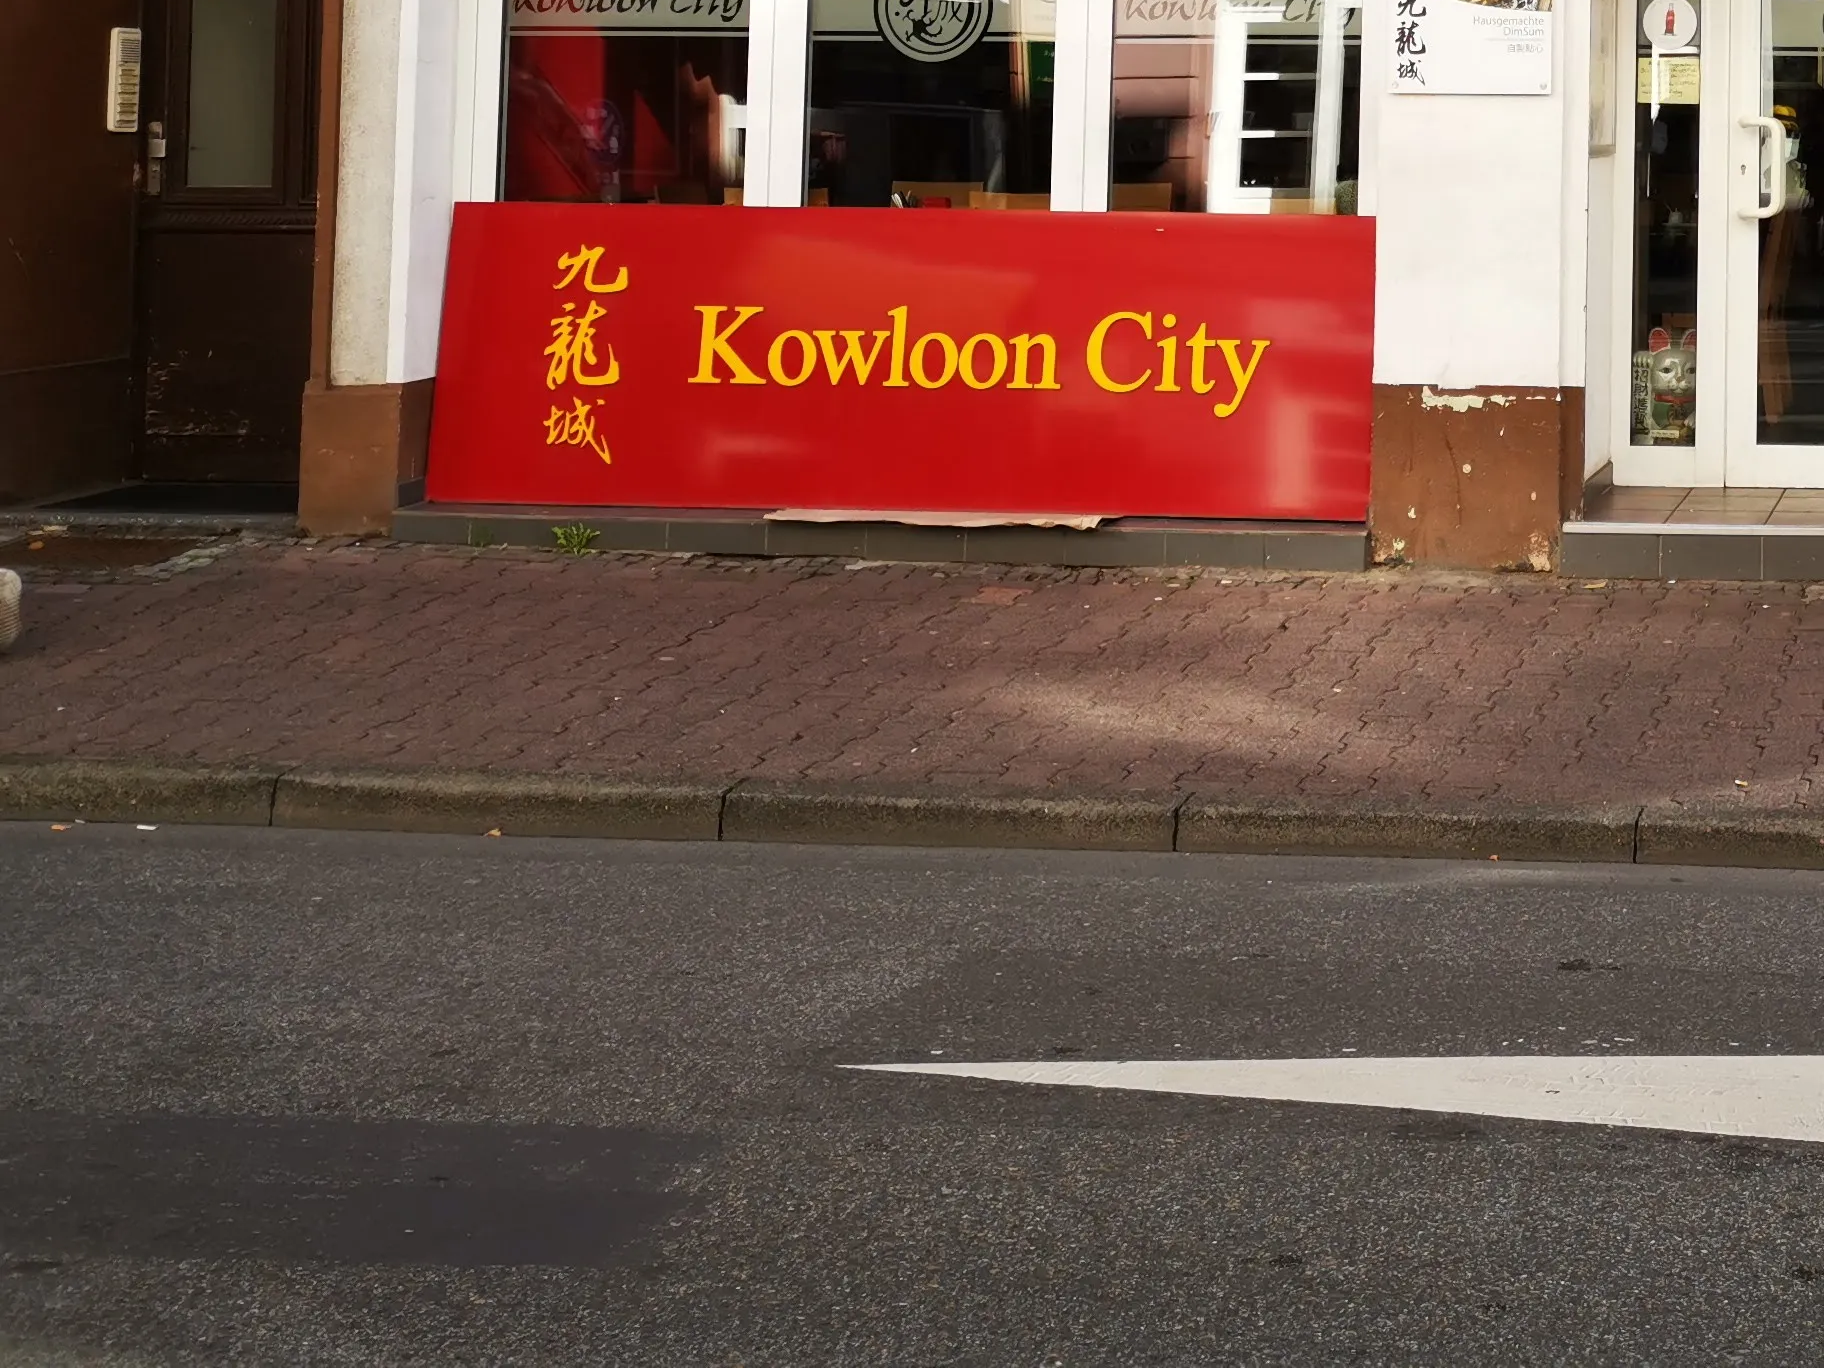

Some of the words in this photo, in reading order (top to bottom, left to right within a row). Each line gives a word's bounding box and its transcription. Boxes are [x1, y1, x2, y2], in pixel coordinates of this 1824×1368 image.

[1472, 16, 1545, 28] Hausgemachte
[542, 243, 630, 465] 九龍城
[687, 304, 1062, 391] Kowloon
[1085, 310, 1272, 419] City
